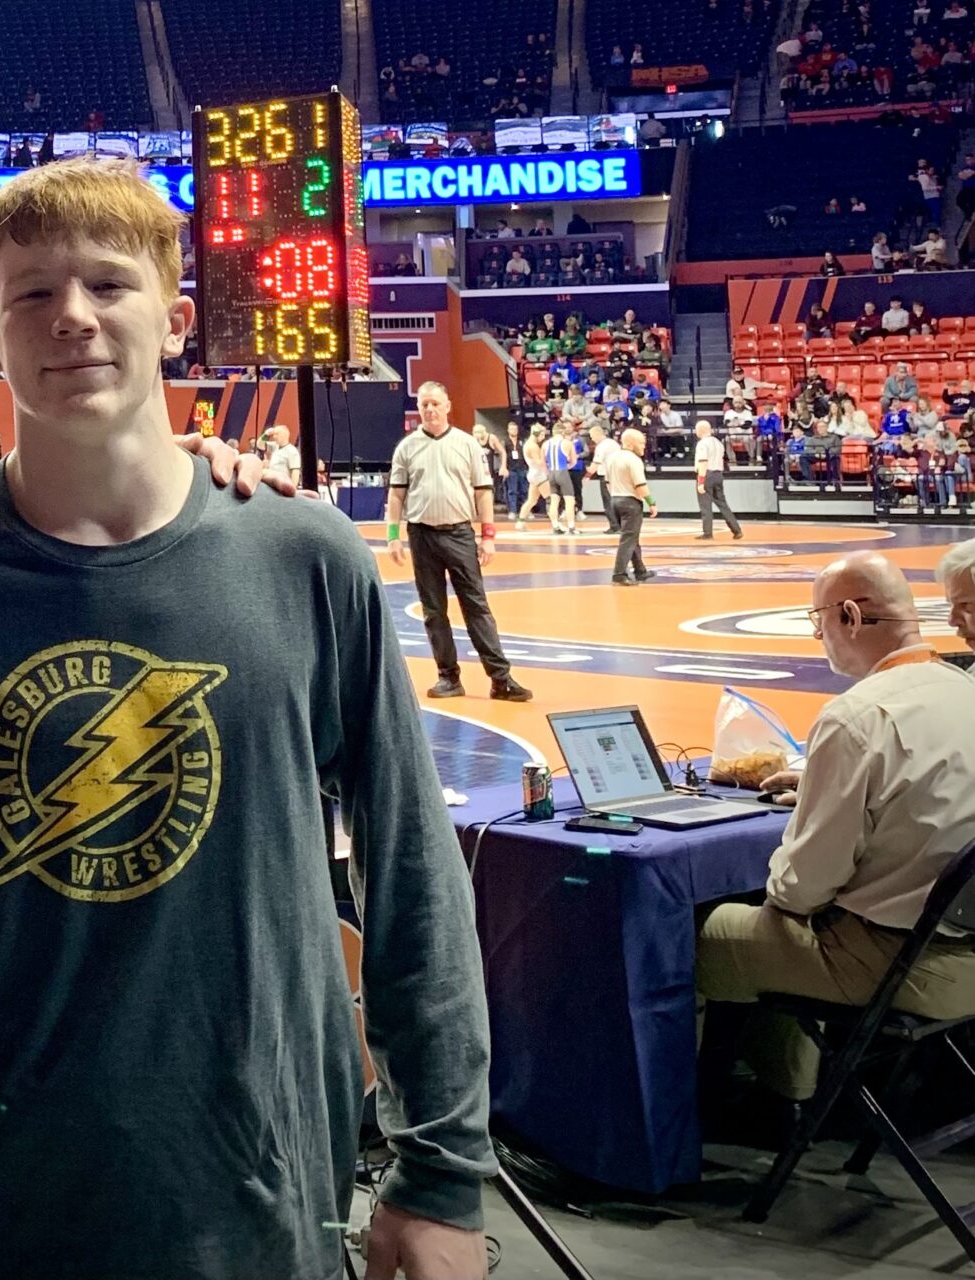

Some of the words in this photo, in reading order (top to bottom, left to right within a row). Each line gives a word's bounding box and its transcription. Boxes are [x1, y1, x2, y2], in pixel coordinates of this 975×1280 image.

[218, 171, 260, 219] 11
[302, 158, 330, 217] 2
[255, 301, 338, 362] 165
[70, 750, 210, 888] WRESTLING
